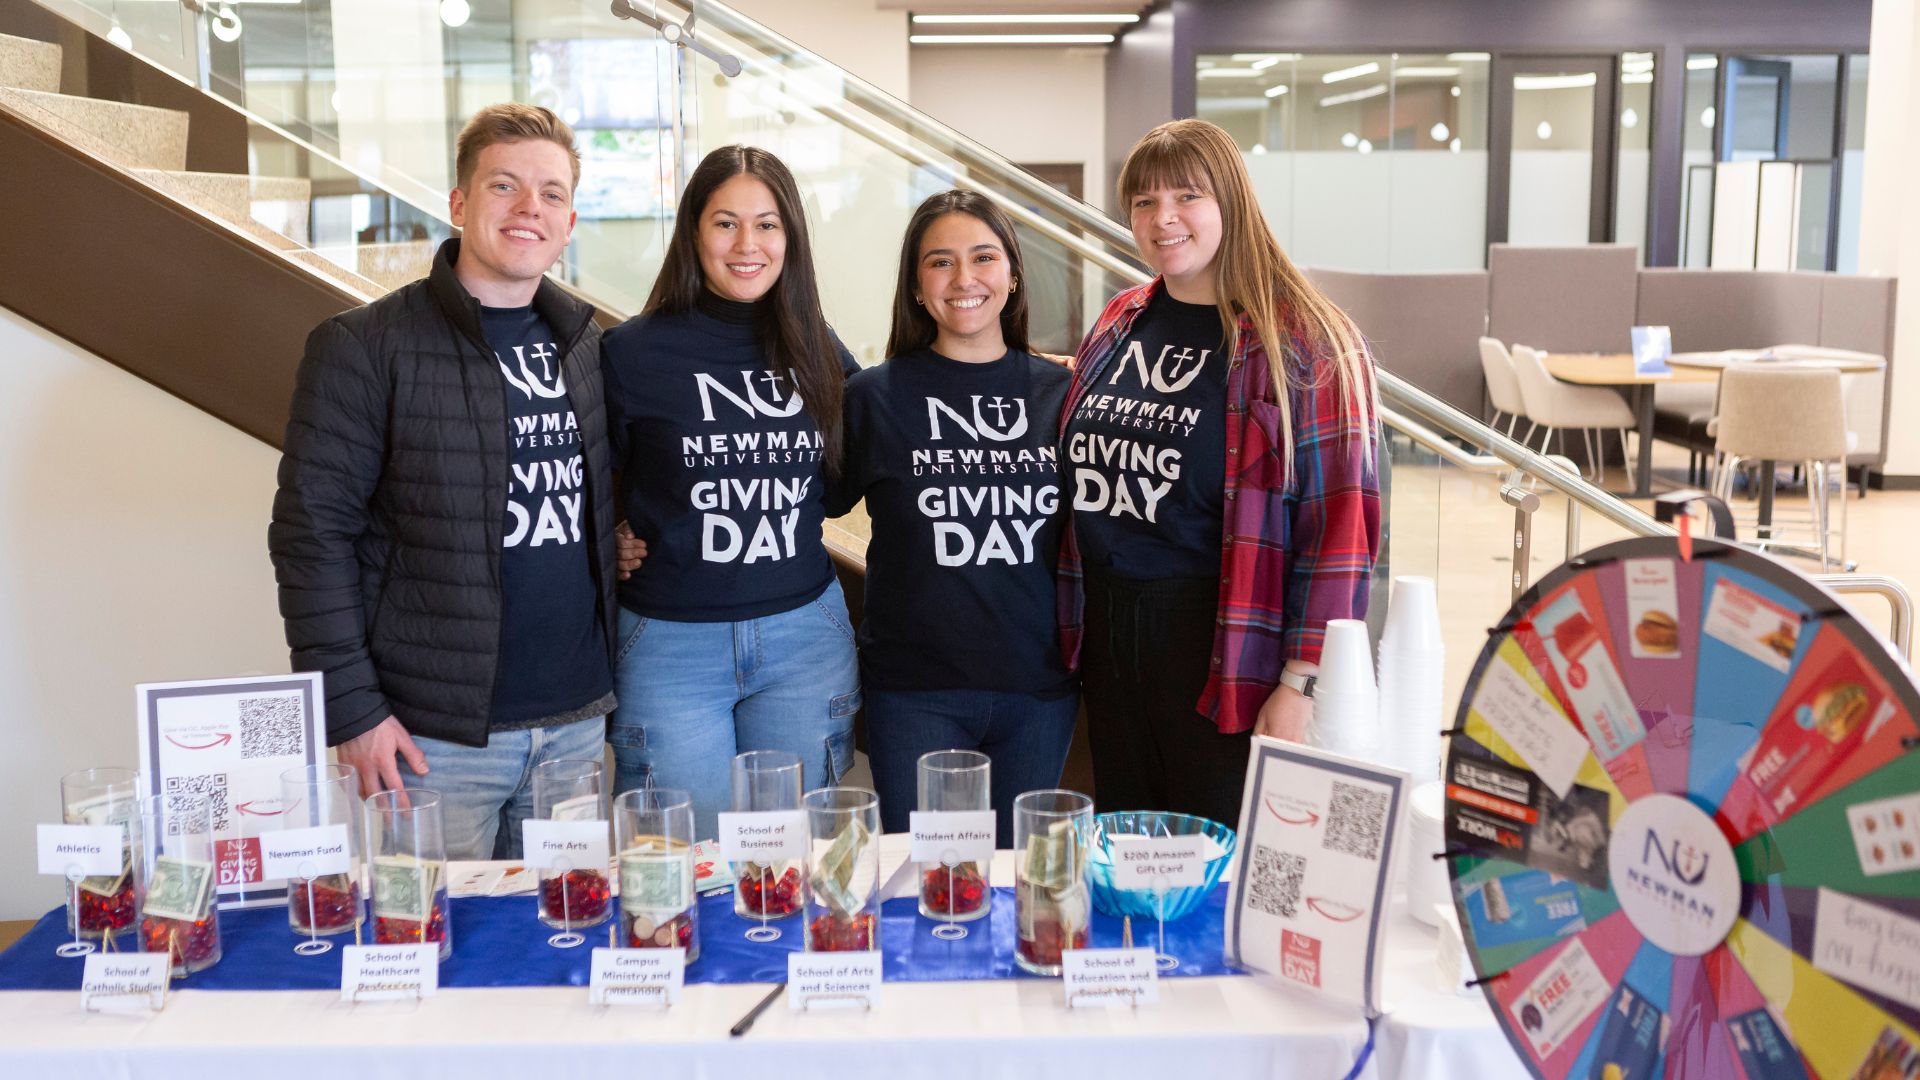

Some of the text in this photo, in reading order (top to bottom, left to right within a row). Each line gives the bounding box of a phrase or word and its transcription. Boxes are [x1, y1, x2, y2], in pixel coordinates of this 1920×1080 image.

[1082, 395, 1201, 425] NEWMAN
[513, 411, 579, 435] WMA
[926, 395, 1029, 442] NU
[1076, 409, 1193, 437] UNIVERSITY
[682, 430, 824, 455] NEWMAN
[684, 450, 823, 468] UNIVERSITY
[912, 446, 1057, 466] NEWMAN
[1070, 432, 1182, 480] GIVING
[913, 462, 1058, 477] UNIVERSITY
[690, 475, 813, 511] GIVING
[917, 484, 1060, 518] GIVING
[1073, 467, 1172, 524] DAY
[503, 492, 581, 548] DAY
[702, 507, 800, 564] DAY
[932, 518, 1047, 567] DAY
[1749, 746, 1788, 788] FREE
[737, 825, 785, 836] School of
[914, 831, 992, 841] Student Affairs
[55, 843, 101, 854] Athletics
[268, 844, 343, 860] Newman Fund
[542, 841, 588, 850] Fine Arts
[740, 840, 784, 849] Business
[1123, 850, 1196, 861] $200 Amazon
[220, 867, 257, 884] DAY
[1136, 864, 1184, 874] Gift Card
[1627, 867, 1715, 919] NEWMAN
[364, 951, 417, 963] School of
[615, 957, 661, 968] Campus
[1083, 957, 1136, 968] School of
[104, 966, 151, 977] School of
[359, 967, 421, 977] Healthcare
[602, 970, 671, 983] Ministry and
[796, 967, 874, 978] School of Arts
[1071, 971, 1150, 983] Education and
[84, 982, 163, 993] Catholic Studies
[800, 983, 871, 993] and Sciences
[1538, 971, 1572, 1010] FREE
